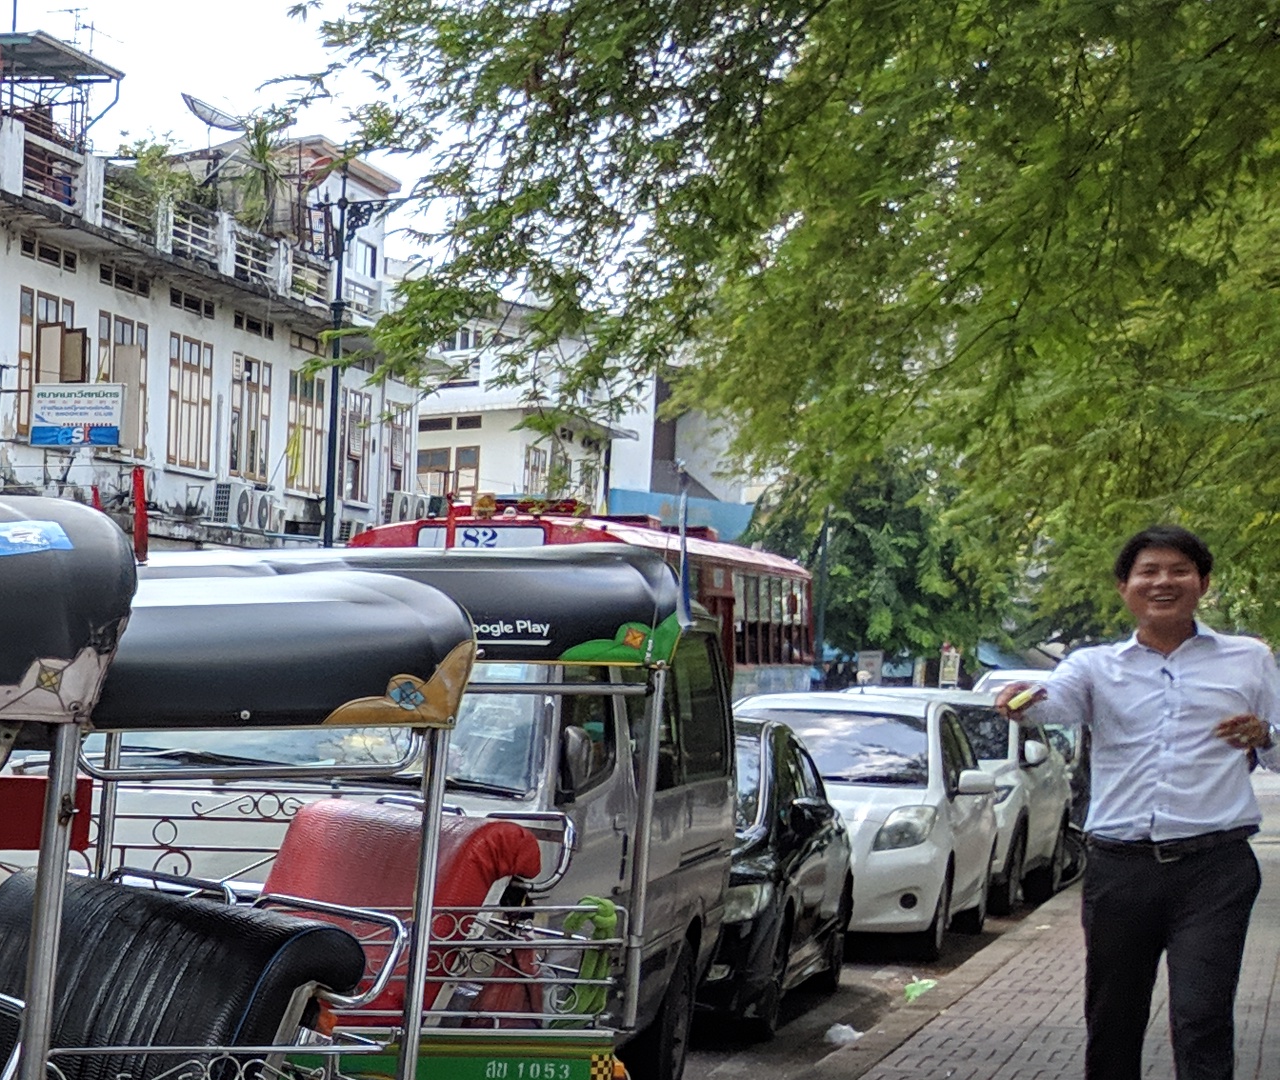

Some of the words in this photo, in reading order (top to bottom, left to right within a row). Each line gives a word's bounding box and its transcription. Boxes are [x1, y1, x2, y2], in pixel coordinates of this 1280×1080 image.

[57, 424, 92, 446] est
[461, 527, 498, 548] 82
[473, 620, 514, 637] oogle
[516, 620, 551, 637] Play
[517, 1062, 571, 1080] 1053
